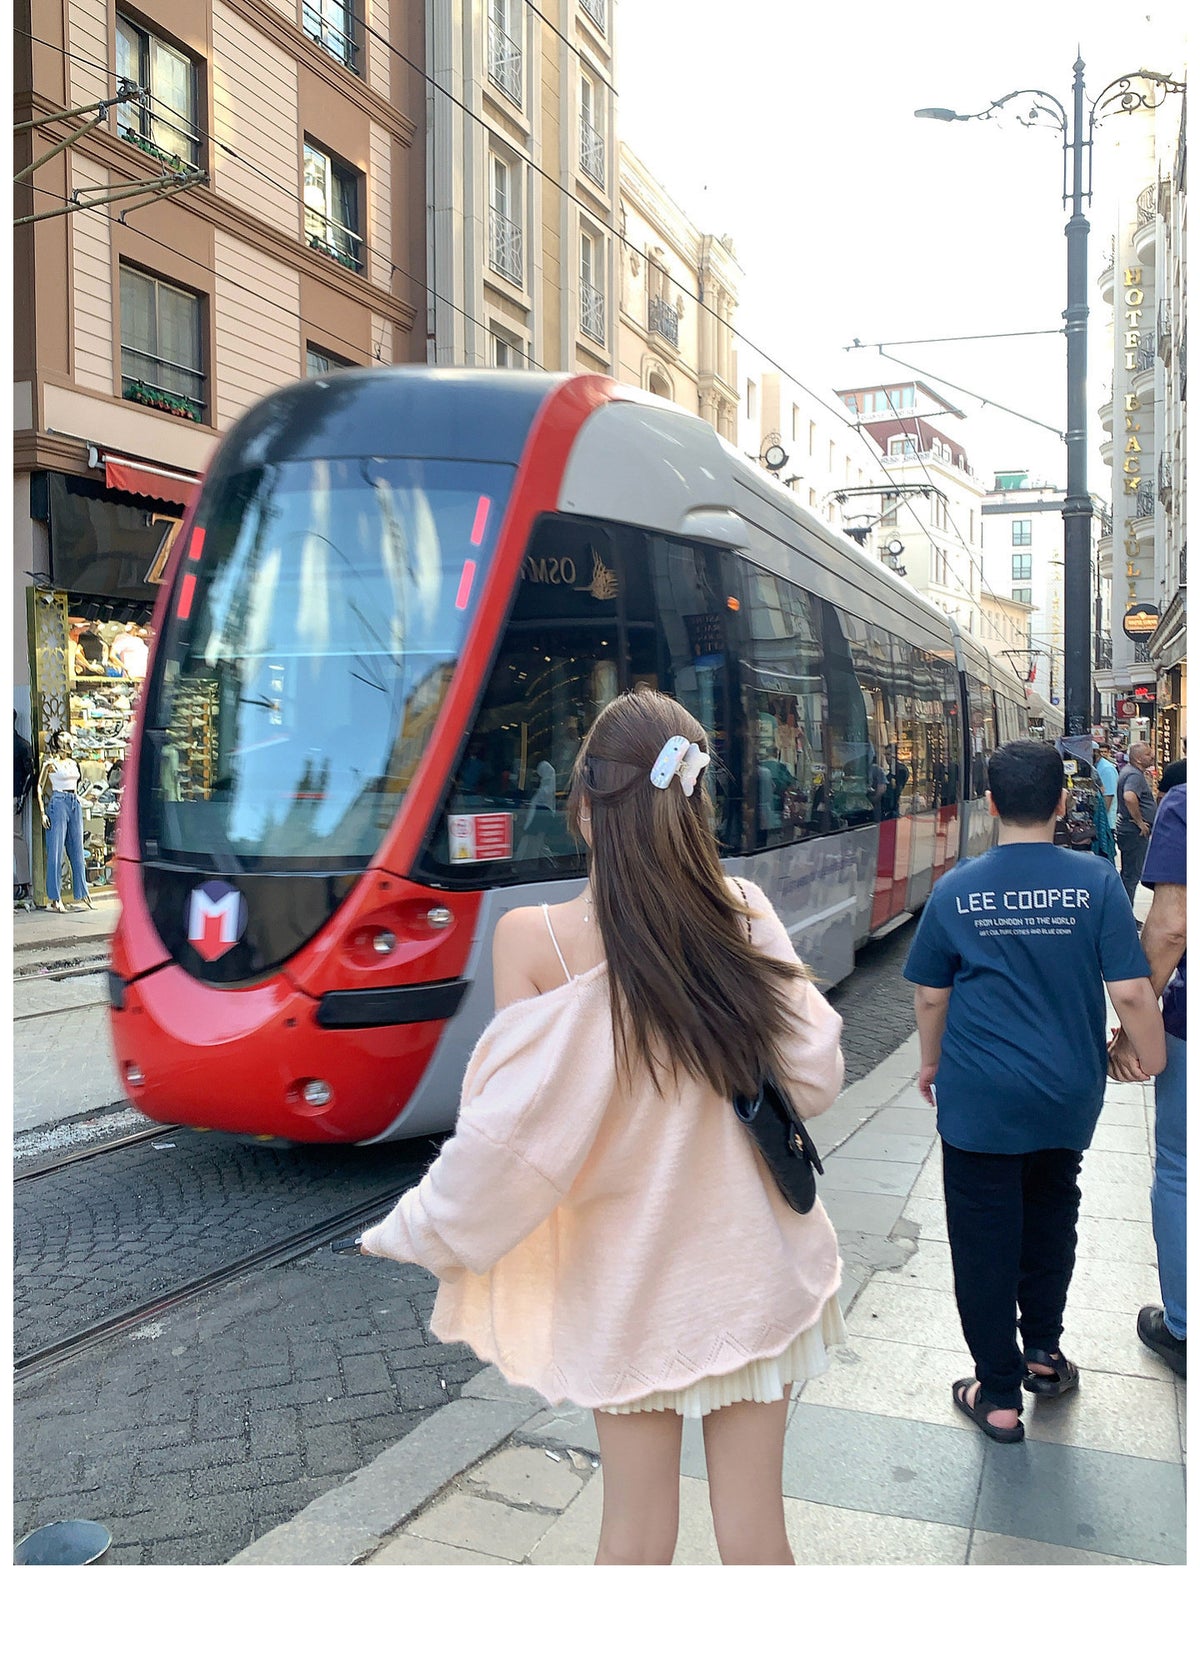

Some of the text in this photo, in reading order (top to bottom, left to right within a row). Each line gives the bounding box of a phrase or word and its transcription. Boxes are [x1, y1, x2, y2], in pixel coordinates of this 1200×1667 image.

[1124, 267, 1144, 370] HOTEL
[1123, 393, 1142, 496] BLACK
[187, 889, 241, 943] M
[955, 888, 1090, 915] LEE COOPER
[974, 916, 1076, 928] FROM LONDON TO THE WORLD
